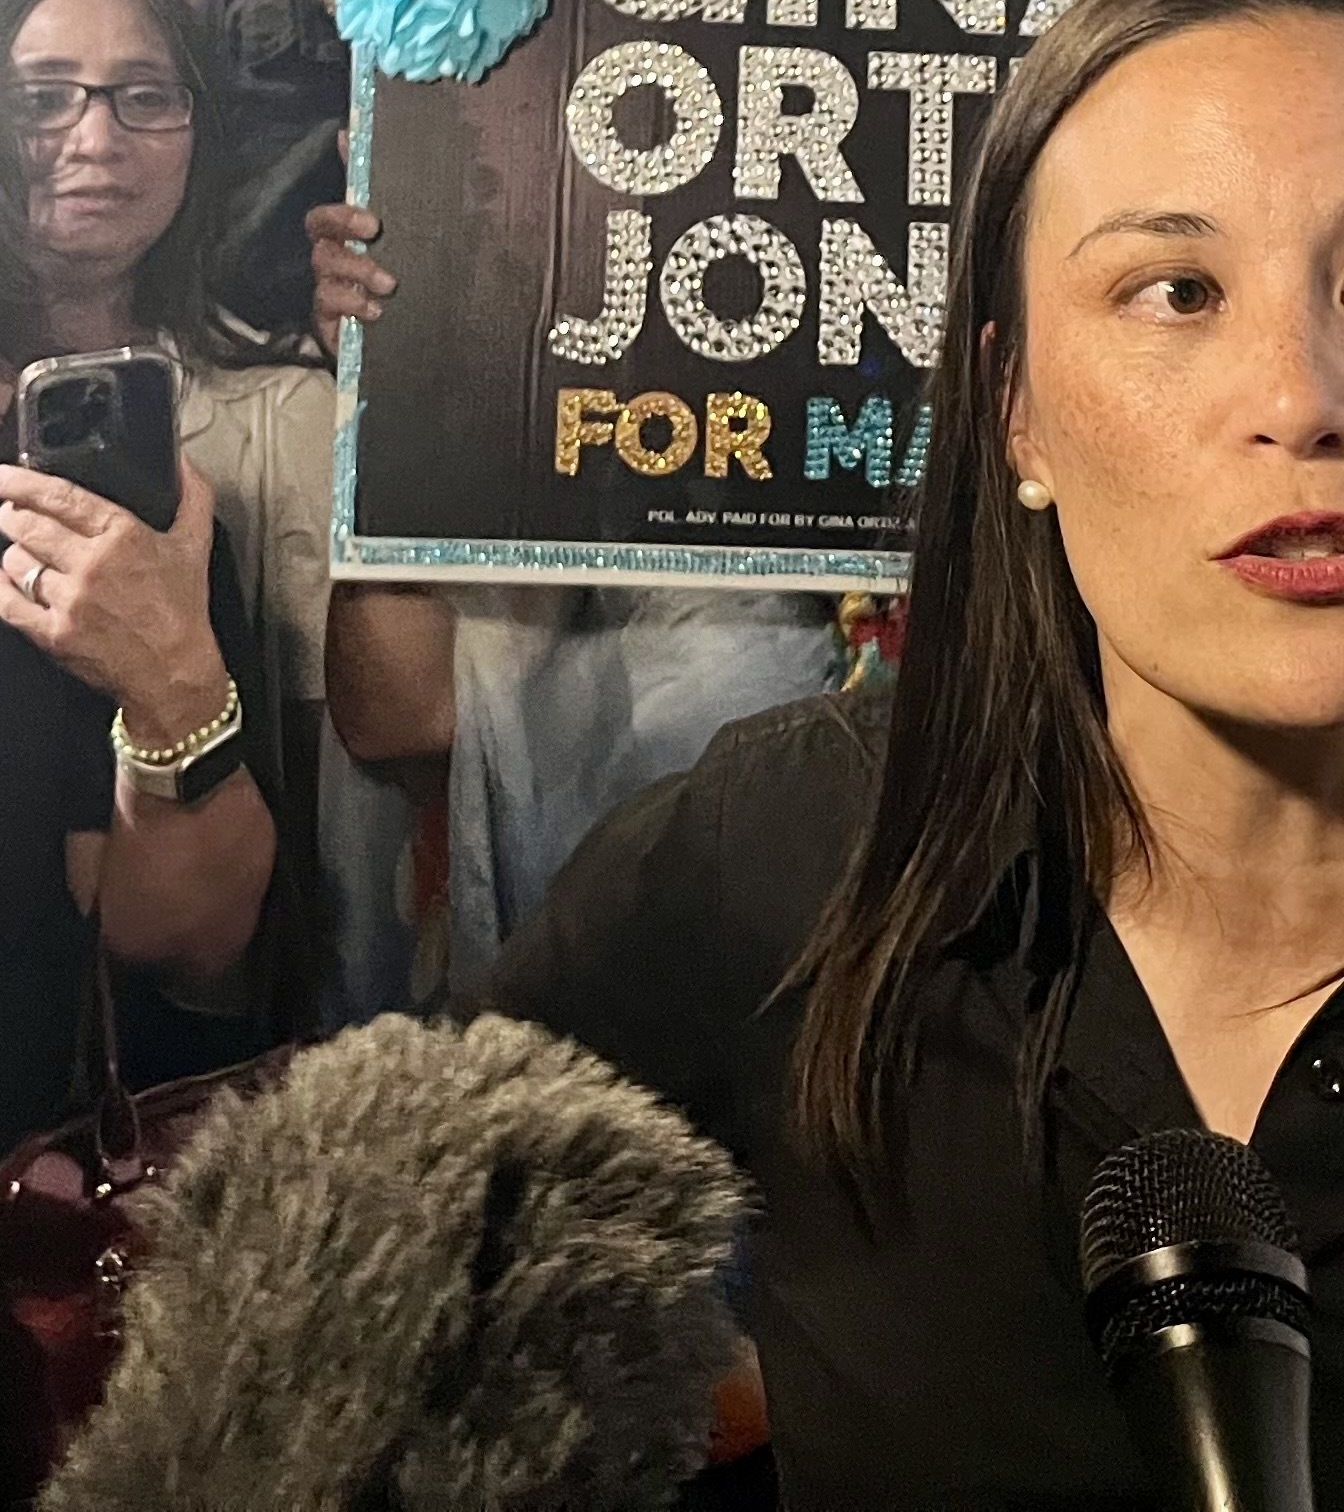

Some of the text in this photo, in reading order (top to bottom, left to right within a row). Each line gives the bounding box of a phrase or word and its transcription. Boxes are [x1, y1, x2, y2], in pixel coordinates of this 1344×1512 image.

[566, 40, 1022, 206] ORT
[548, 209, 952, 367] JON
[552, 387, 774, 481] FOR
[794, 514, 815, 527] BY
[818, 515, 855, 528] GINA
